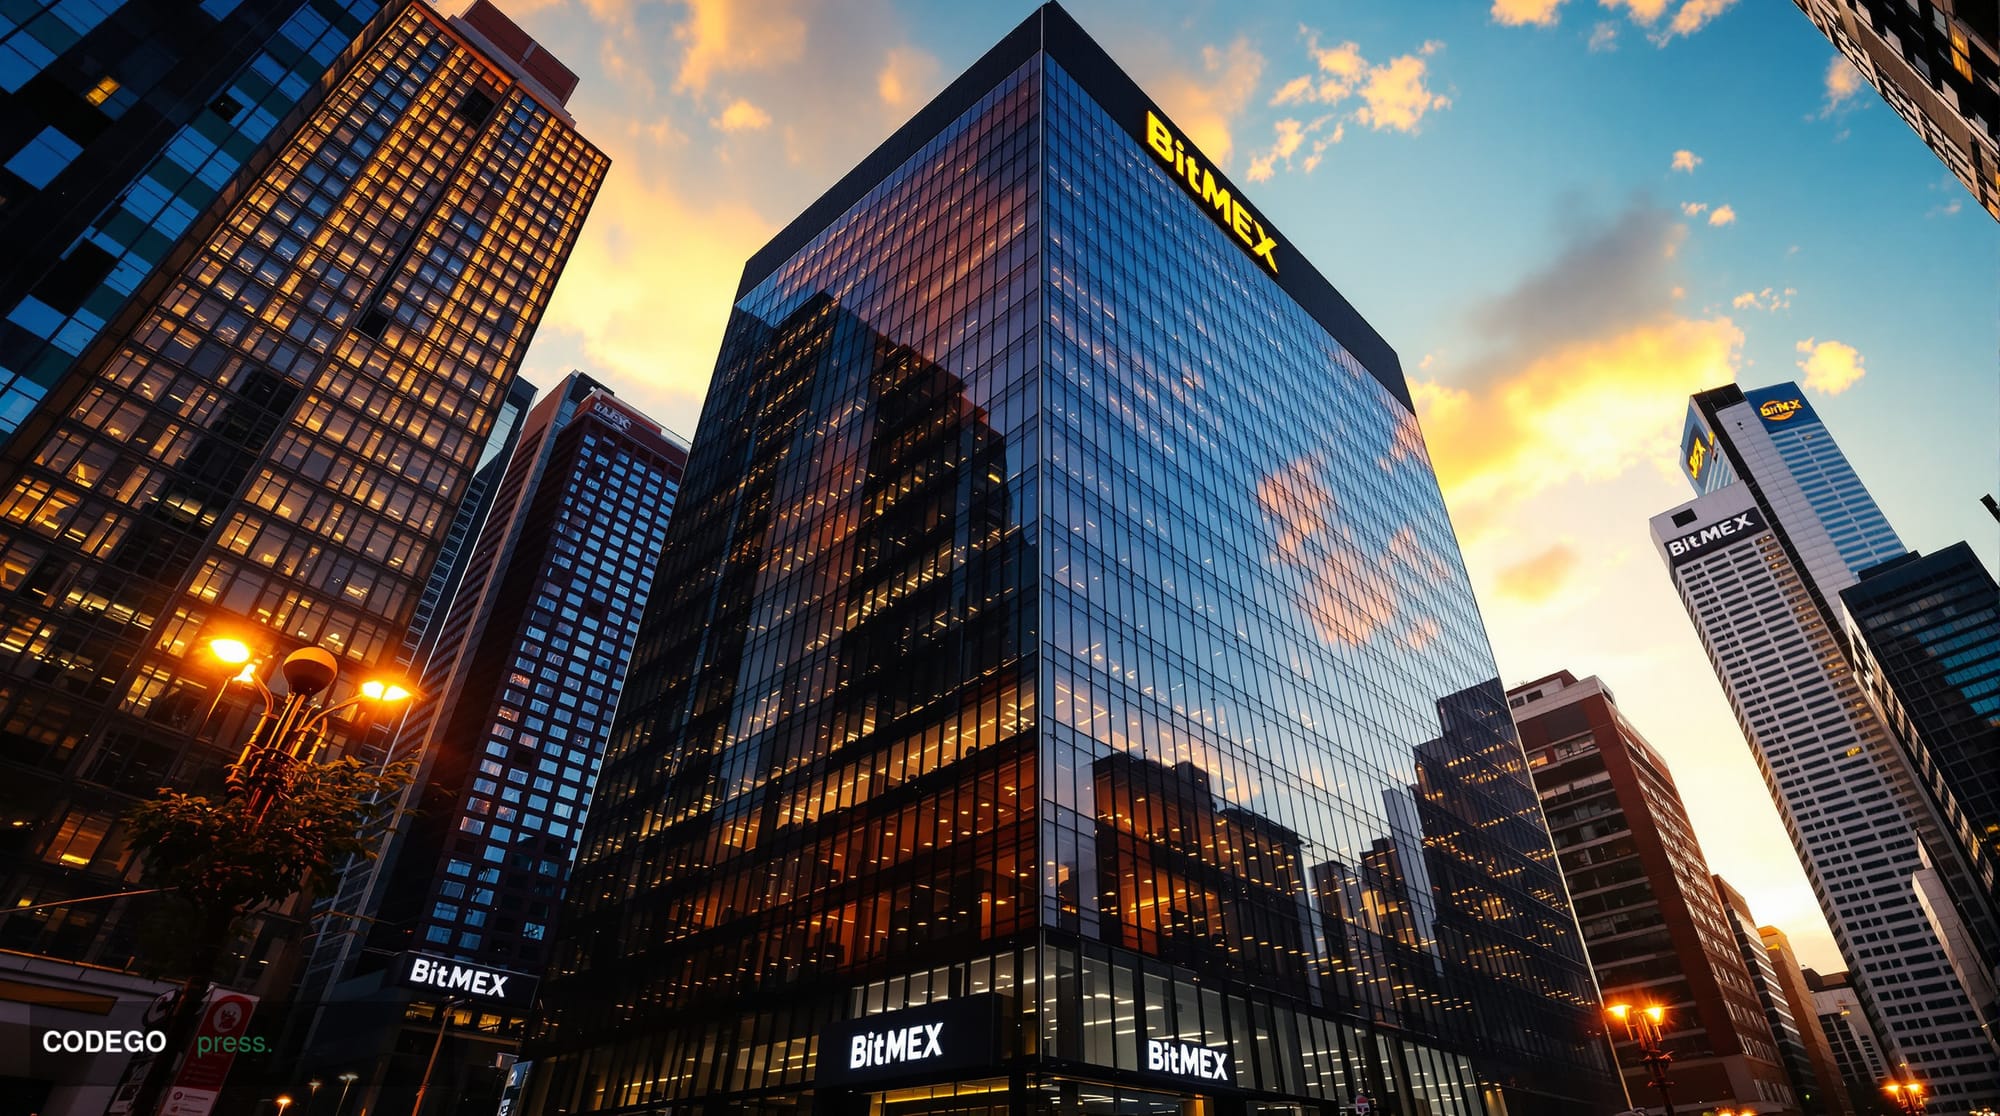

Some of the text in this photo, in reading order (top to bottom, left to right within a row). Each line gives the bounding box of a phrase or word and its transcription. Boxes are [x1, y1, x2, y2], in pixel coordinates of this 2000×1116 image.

[1147, 111, 1278, 273] BitMEX
[409, 958, 508, 998] BitMEX
[850, 1022, 944, 1070] BitMEX
[1148, 1039, 1229, 1081] BitMEX
